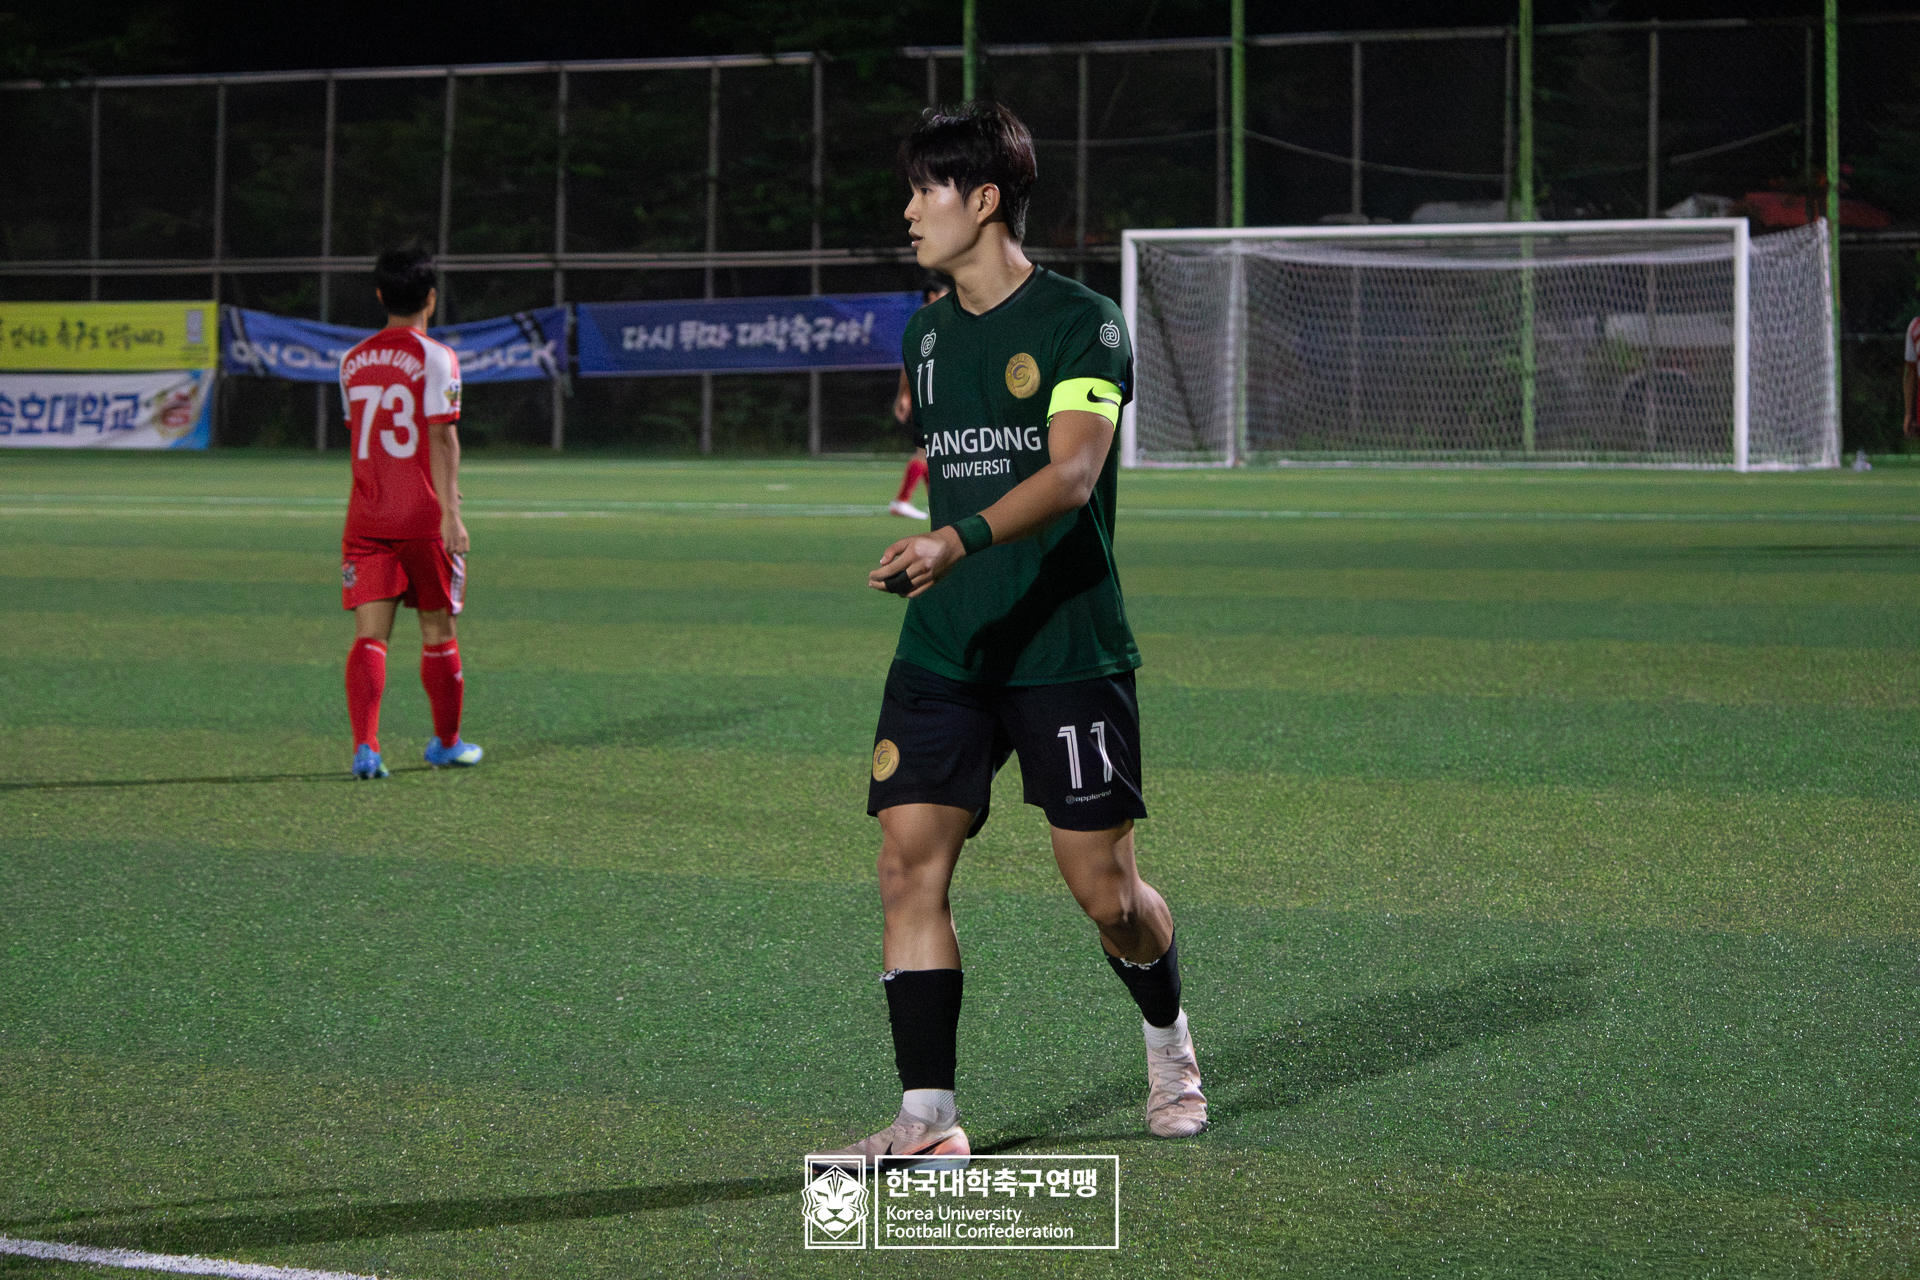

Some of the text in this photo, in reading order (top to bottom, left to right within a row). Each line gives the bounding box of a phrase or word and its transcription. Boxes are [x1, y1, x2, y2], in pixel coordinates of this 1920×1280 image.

[622, 325, 675, 350] 다시
[736, 311, 875, 353] 대학축구야!
[916, 358, 935, 408] 11
[349, 383, 420, 461] 73
[1057, 721, 1113, 789] 11
